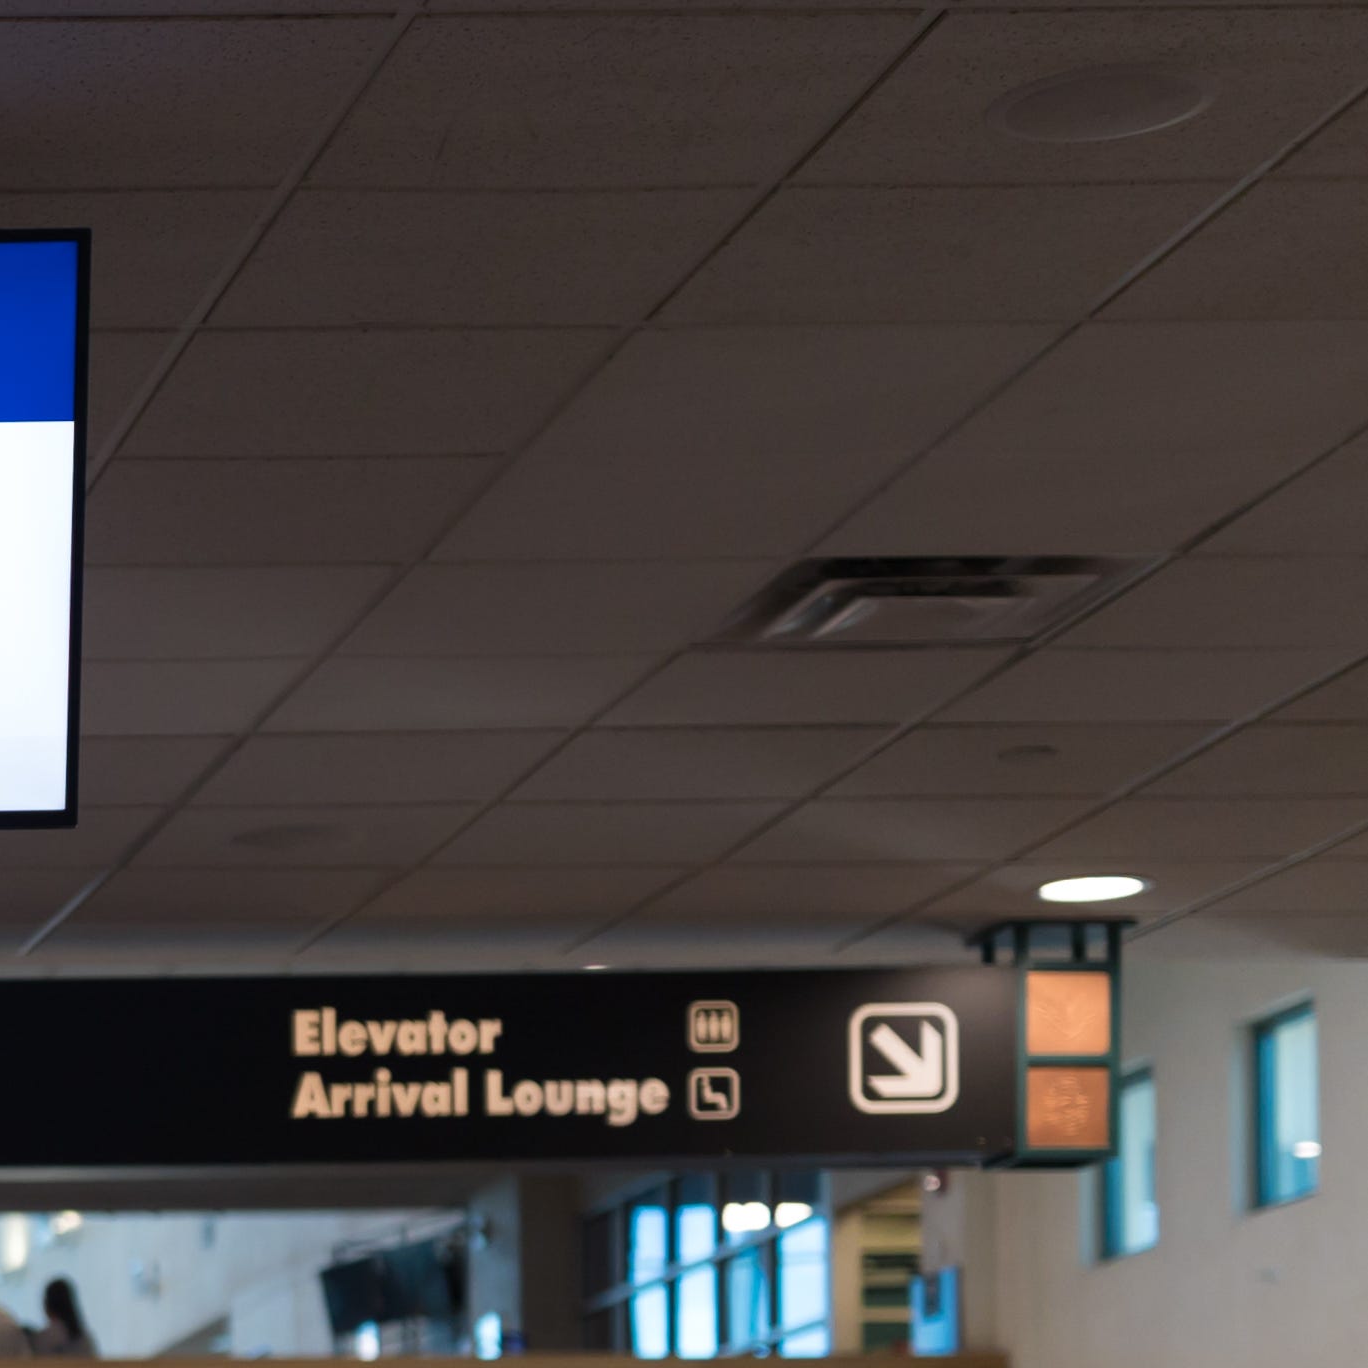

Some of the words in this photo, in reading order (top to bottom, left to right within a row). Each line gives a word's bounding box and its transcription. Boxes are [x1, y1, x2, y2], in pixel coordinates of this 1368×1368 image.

[292, 1007, 503, 1057] Elevator
[291, 1067, 470, 1119] Arrival
[484, 1069, 671, 1126] Lounge
